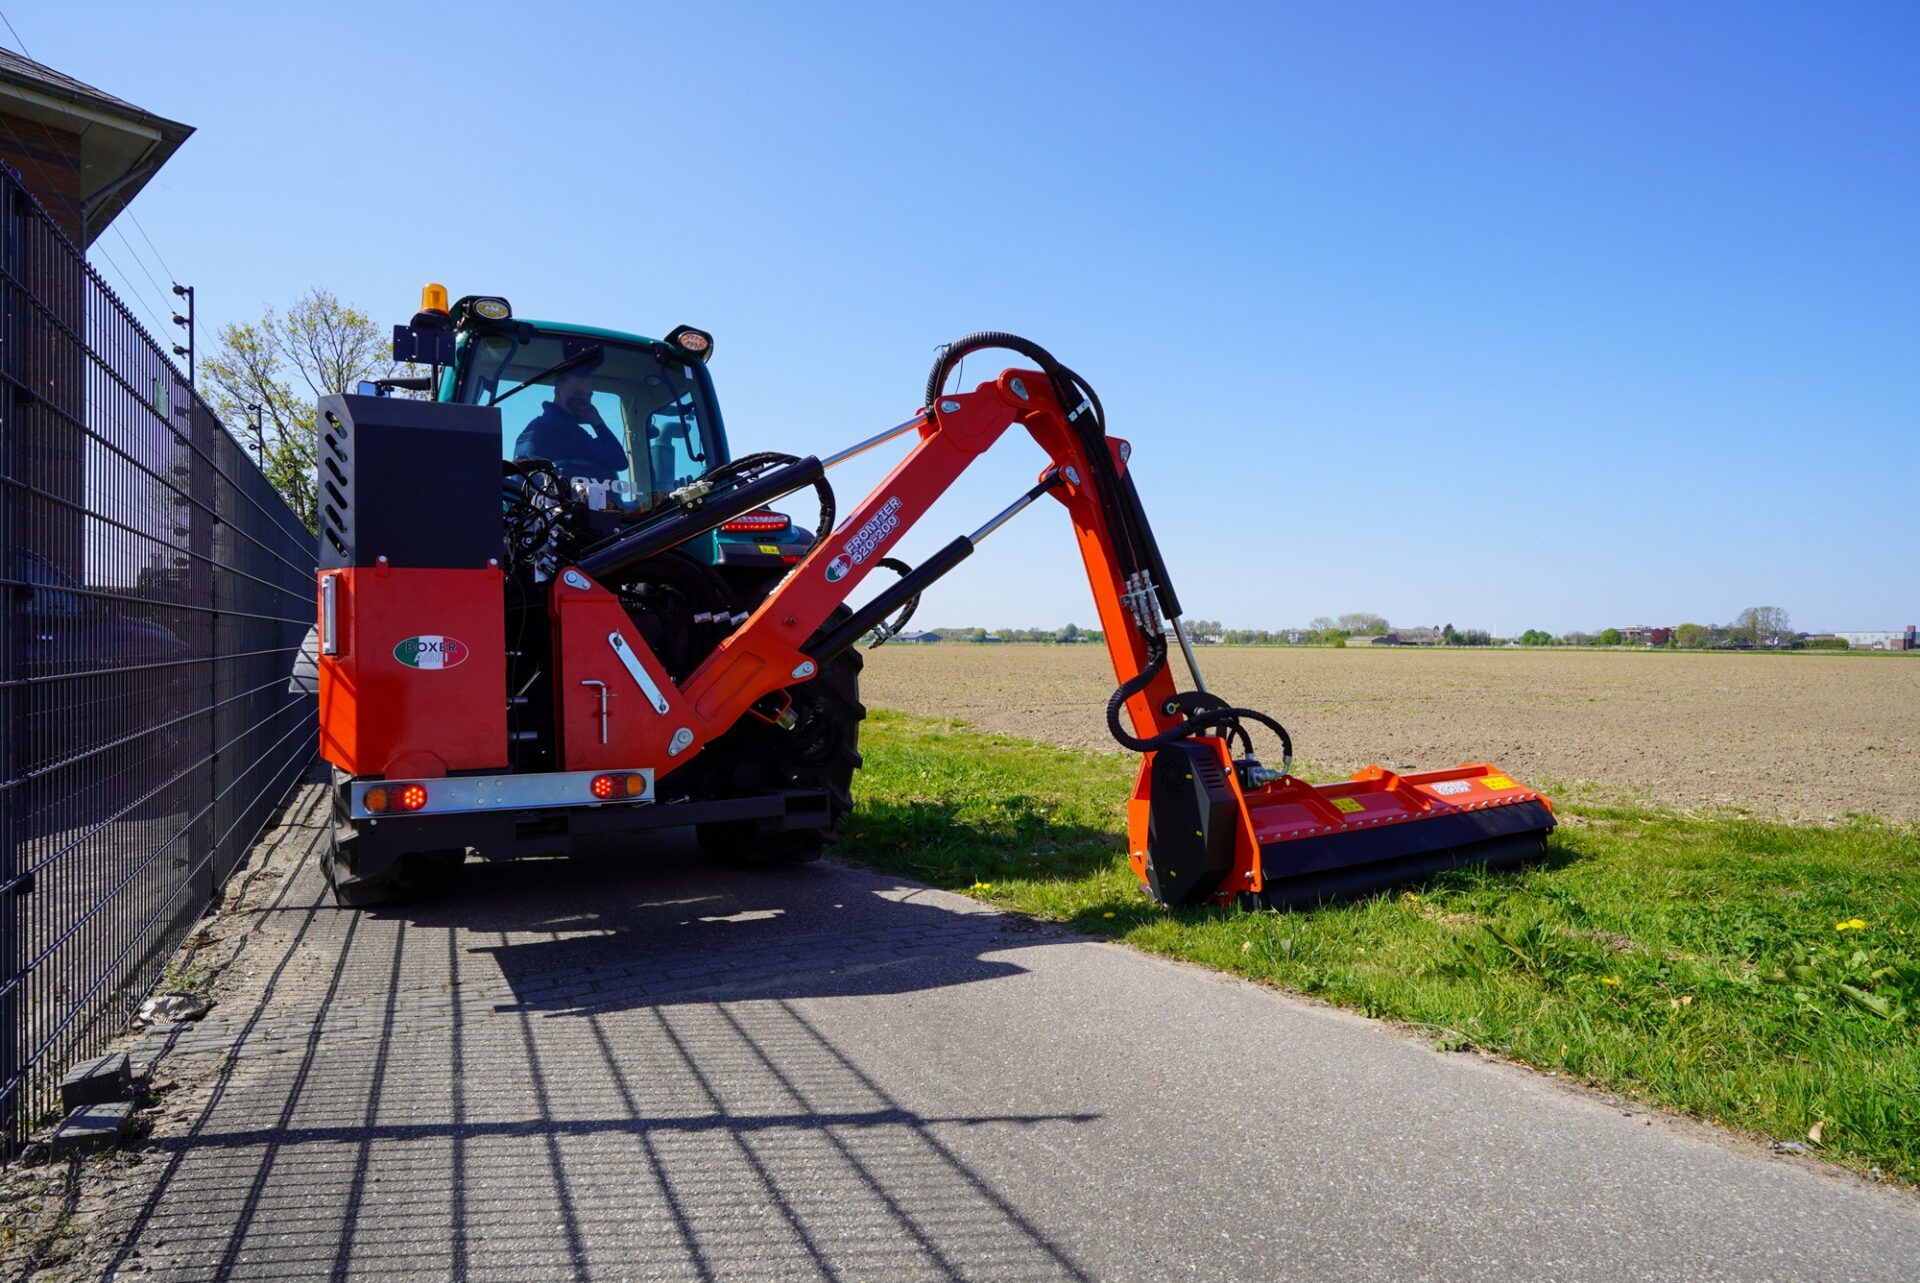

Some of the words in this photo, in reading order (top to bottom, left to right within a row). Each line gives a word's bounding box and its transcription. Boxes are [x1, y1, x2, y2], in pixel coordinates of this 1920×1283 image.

[570, 476, 644, 496] OVOL
[844, 497, 901, 555] FRONTIER
[852, 515, 898, 563] 520-200
[405, 642, 456, 653] BOXER
[414, 652, 449, 662] AGRI
